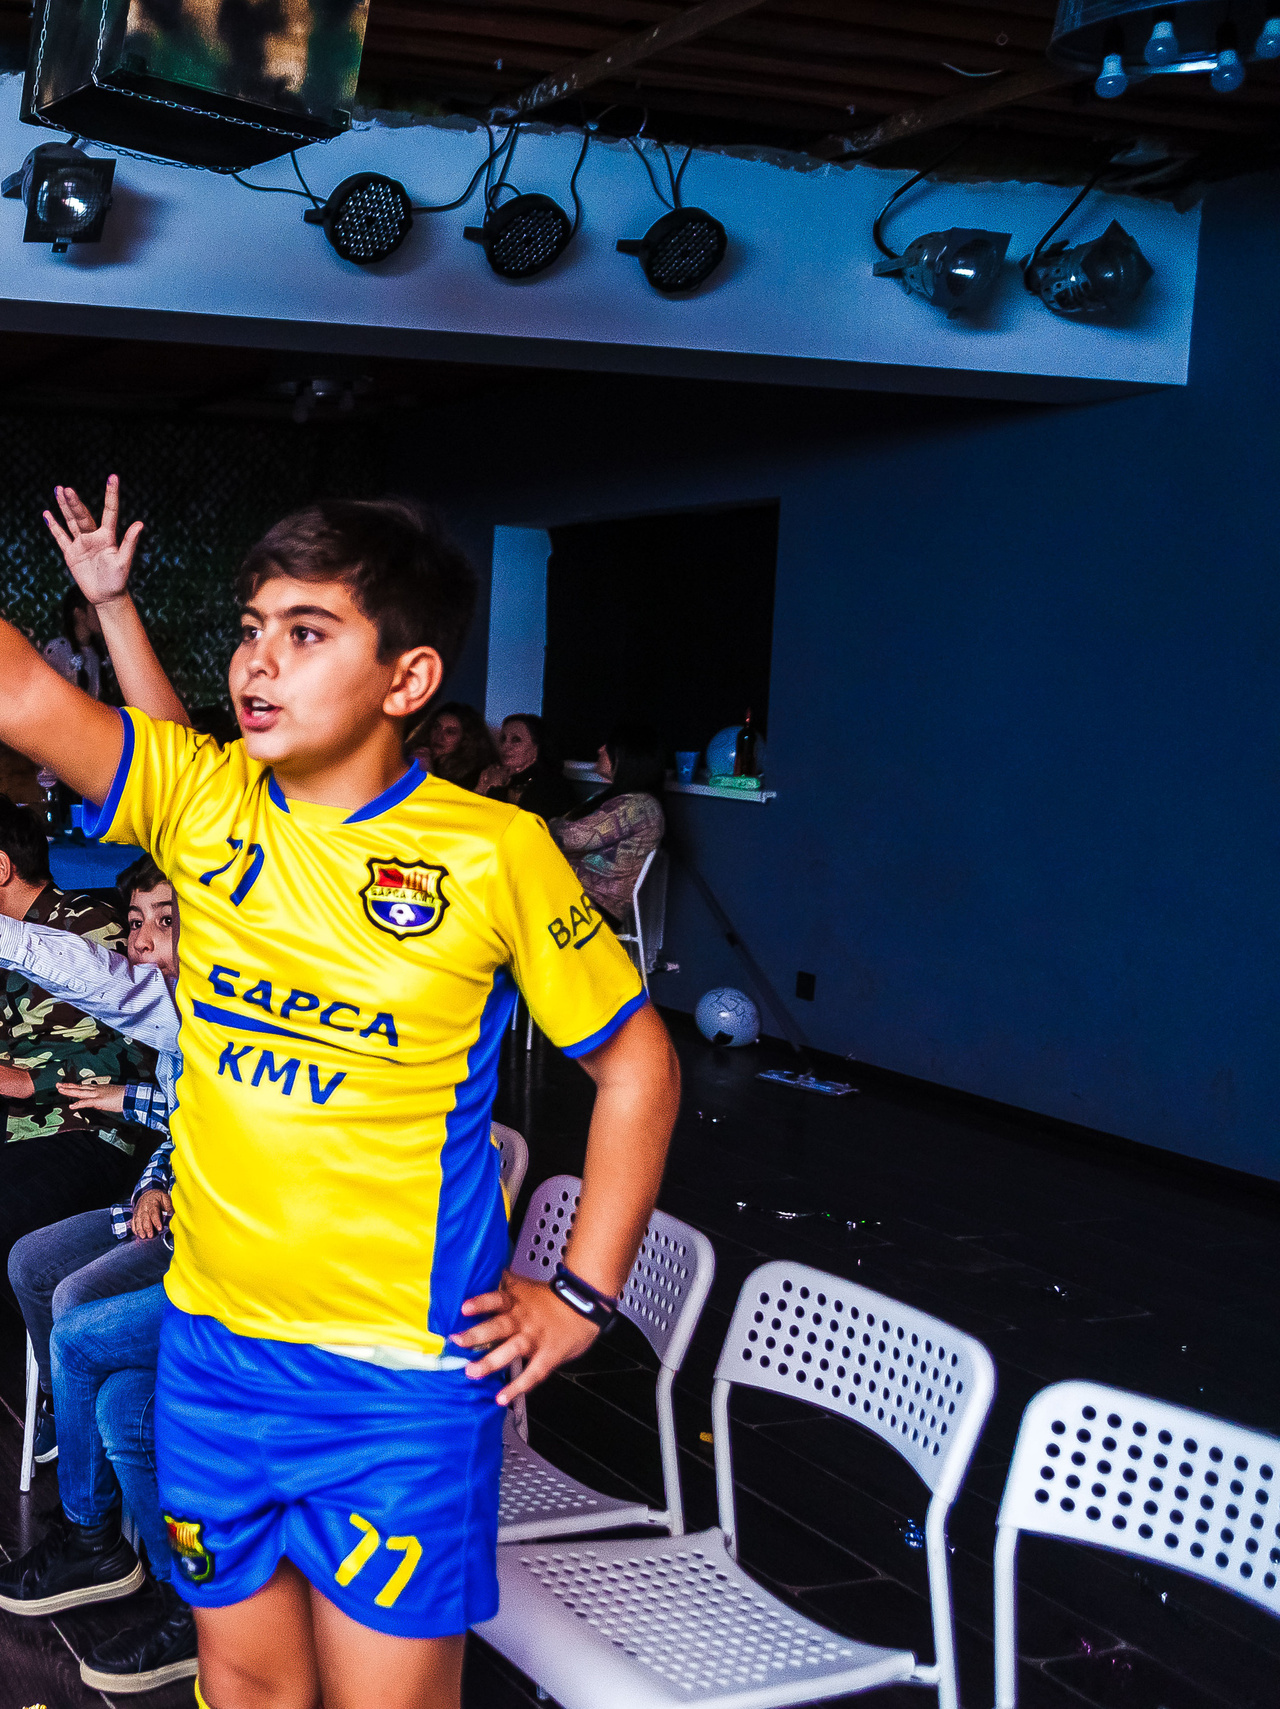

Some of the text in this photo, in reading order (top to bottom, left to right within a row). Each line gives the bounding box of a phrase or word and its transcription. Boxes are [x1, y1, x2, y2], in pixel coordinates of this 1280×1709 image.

[199, 836, 265, 907] 77
[218, 1041, 347, 1105] KMV
[334, 1513, 423, 1608] 77
